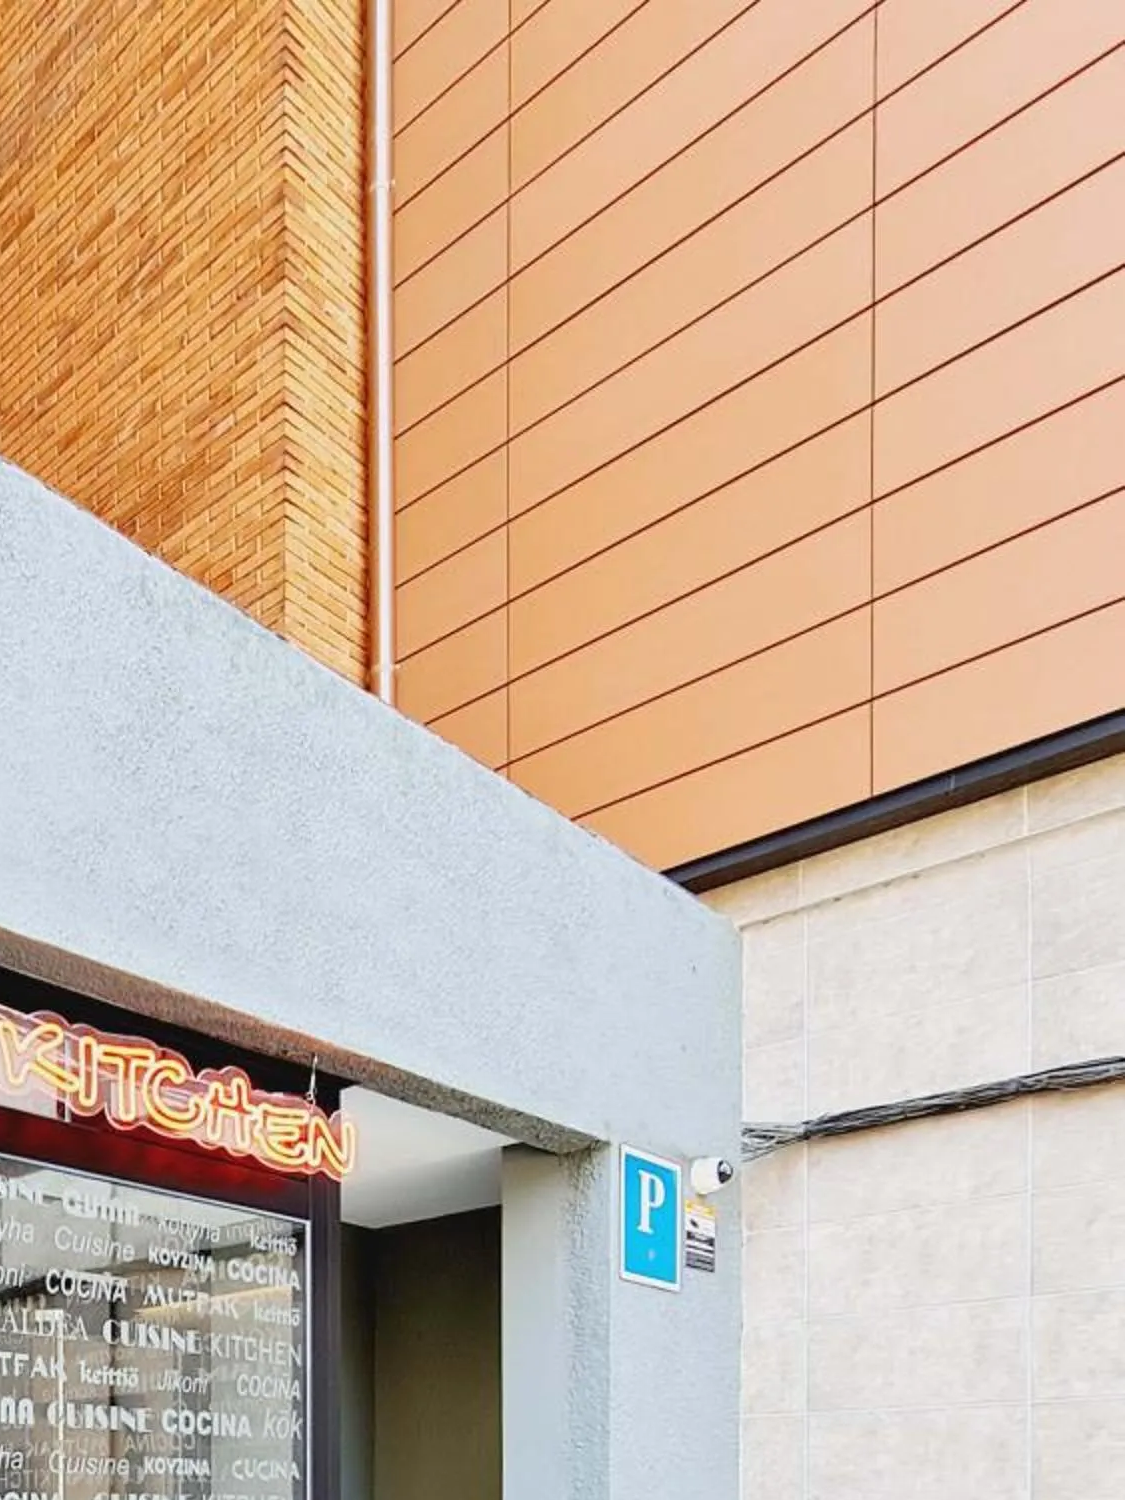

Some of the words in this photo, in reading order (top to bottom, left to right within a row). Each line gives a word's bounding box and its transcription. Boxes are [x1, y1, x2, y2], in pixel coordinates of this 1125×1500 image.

[637, 1168, 666, 1235] P
[55, 1225, 136, 1263] Cuisine
[226, 1258, 303, 1292] COCINA
[102, 1318, 204, 1356] CUISINE
[210, 1332, 303, 1369] KITCHEN
[46, 1402, 153, 1433] CUISINE
[161, 1407, 252, 1438] COCINA
[48, 1450, 131, 1477] Cuisine
